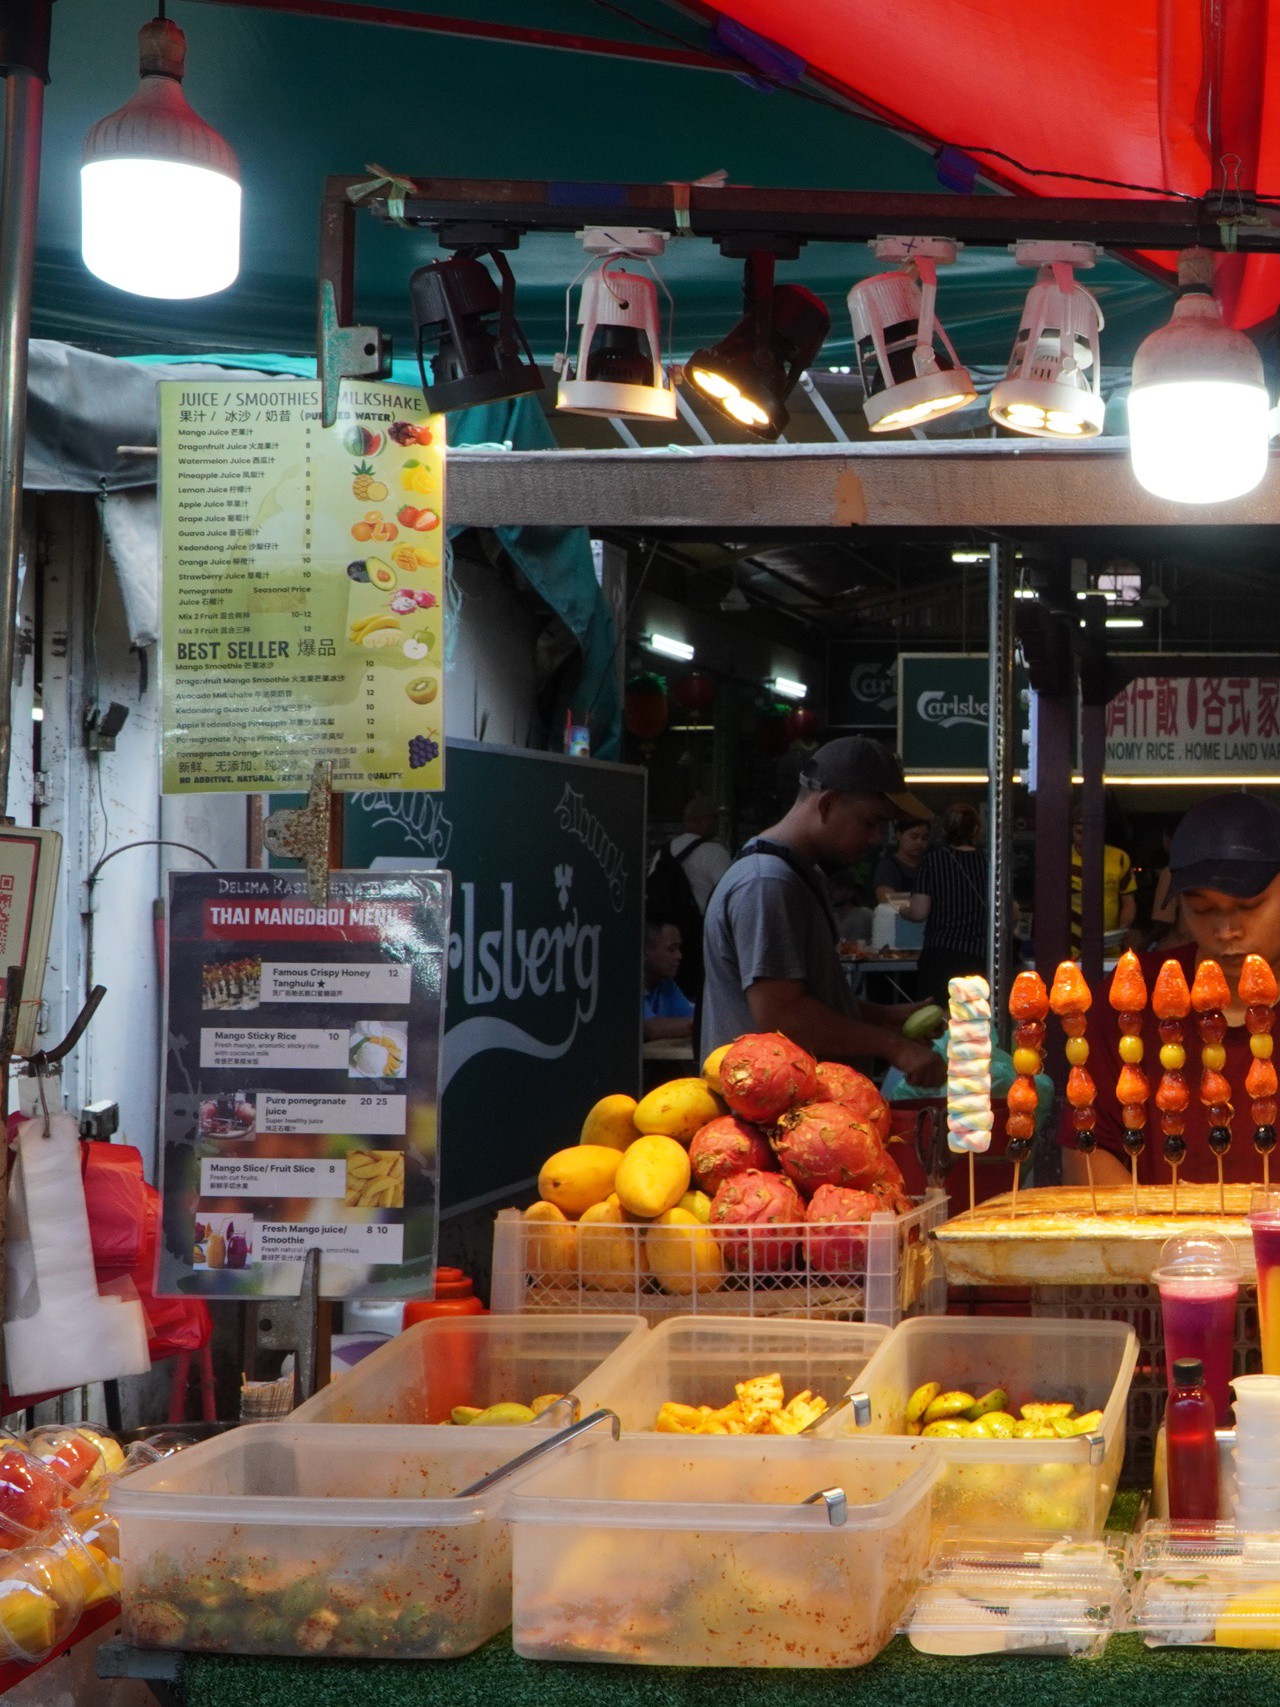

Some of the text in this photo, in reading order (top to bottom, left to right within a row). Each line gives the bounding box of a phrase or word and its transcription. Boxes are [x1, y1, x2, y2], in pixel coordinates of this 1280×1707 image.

[179, 392, 422, 412] JUICE SMOOTHIES MILKSHAKE
[180, 410, 206, 422] 果汁
[225, 410, 251, 422] 冰沙
[266, 410, 290, 422] 奶昔
[356, 412, 396, 422] WATER)
[178, 444, 224, 452] Dragonfruit
[179, 588, 232, 596] Pomegranate
[178, 639, 336, 660] BEST SELLER 爆品
[917, 691, 989, 722] Carlsbe
[1106, 742, 1142, 760] NOMY
[1146, 742, 1174, 760] RICE
[1185, 742, 1222, 760] HOME
[1225, 742, 1257, 760] LAND
[210, 908, 249, 924] THAI
[255, 906, 344, 926] MANGOBOI
[273, 968, 398, 979] Famous Crispy Honey 12
[273, 980, 314, 989] Tanghulu
[215, 1032, 246, 1041] Mango
[247, 1032, 275, 1041] Sticky
[277, 1032, 296, 1040] Rice
[288, 1098, 346, 1106] pomegranate
[266, 1108, 287, 1116] juice
[290, 1225, 320, 1235] Mango
[321, 1226, 347, 1234] juice/
[377, 1226, 388, 1234] 10
